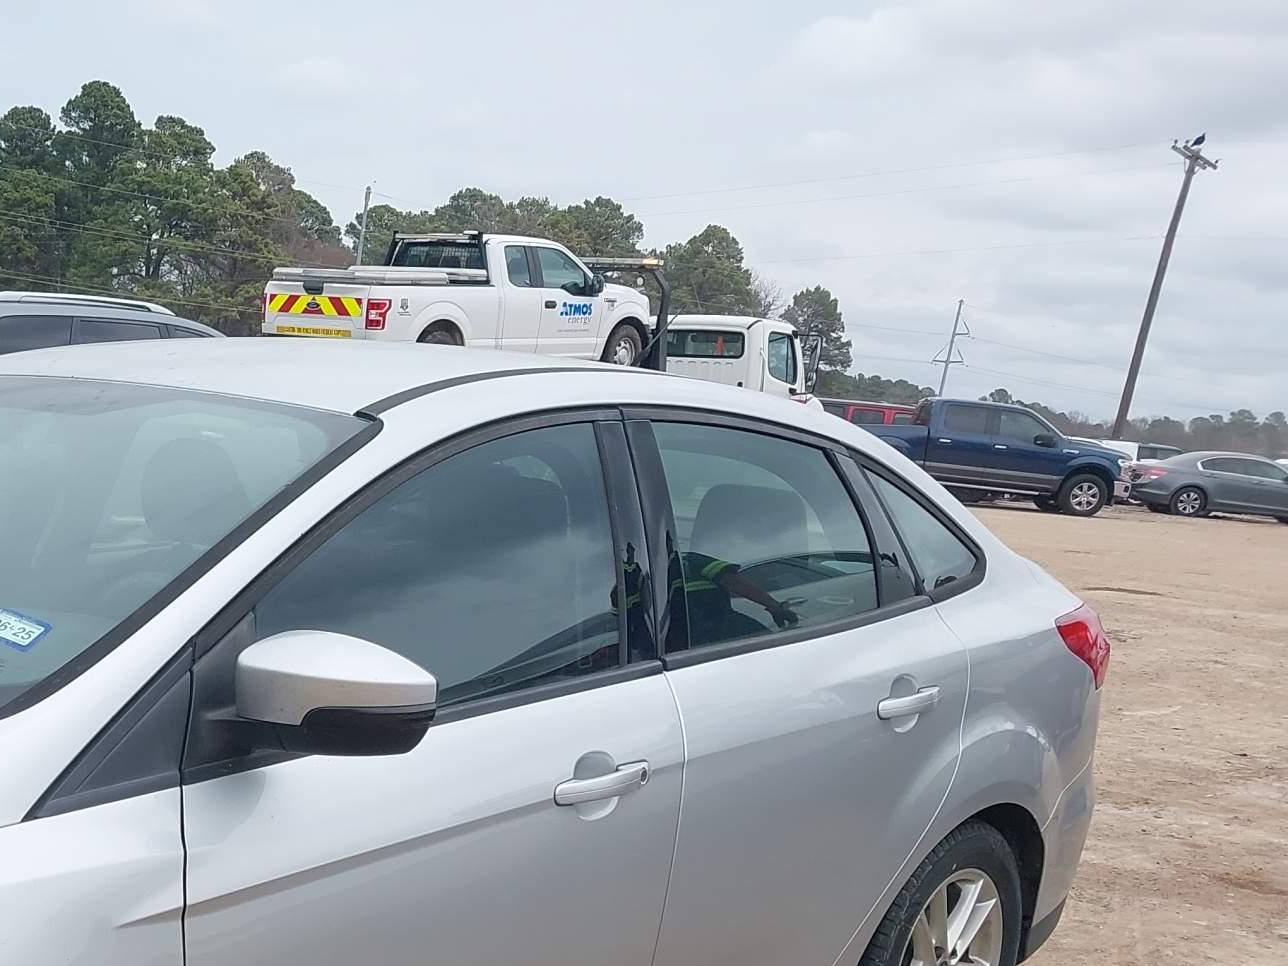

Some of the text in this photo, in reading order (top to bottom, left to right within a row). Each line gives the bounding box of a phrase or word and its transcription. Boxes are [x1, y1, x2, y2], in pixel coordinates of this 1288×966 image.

[560, 301, 593, 317] ATMOS
[567, 316, 592, 326] energy
[11, 626, 36, 641] 25
